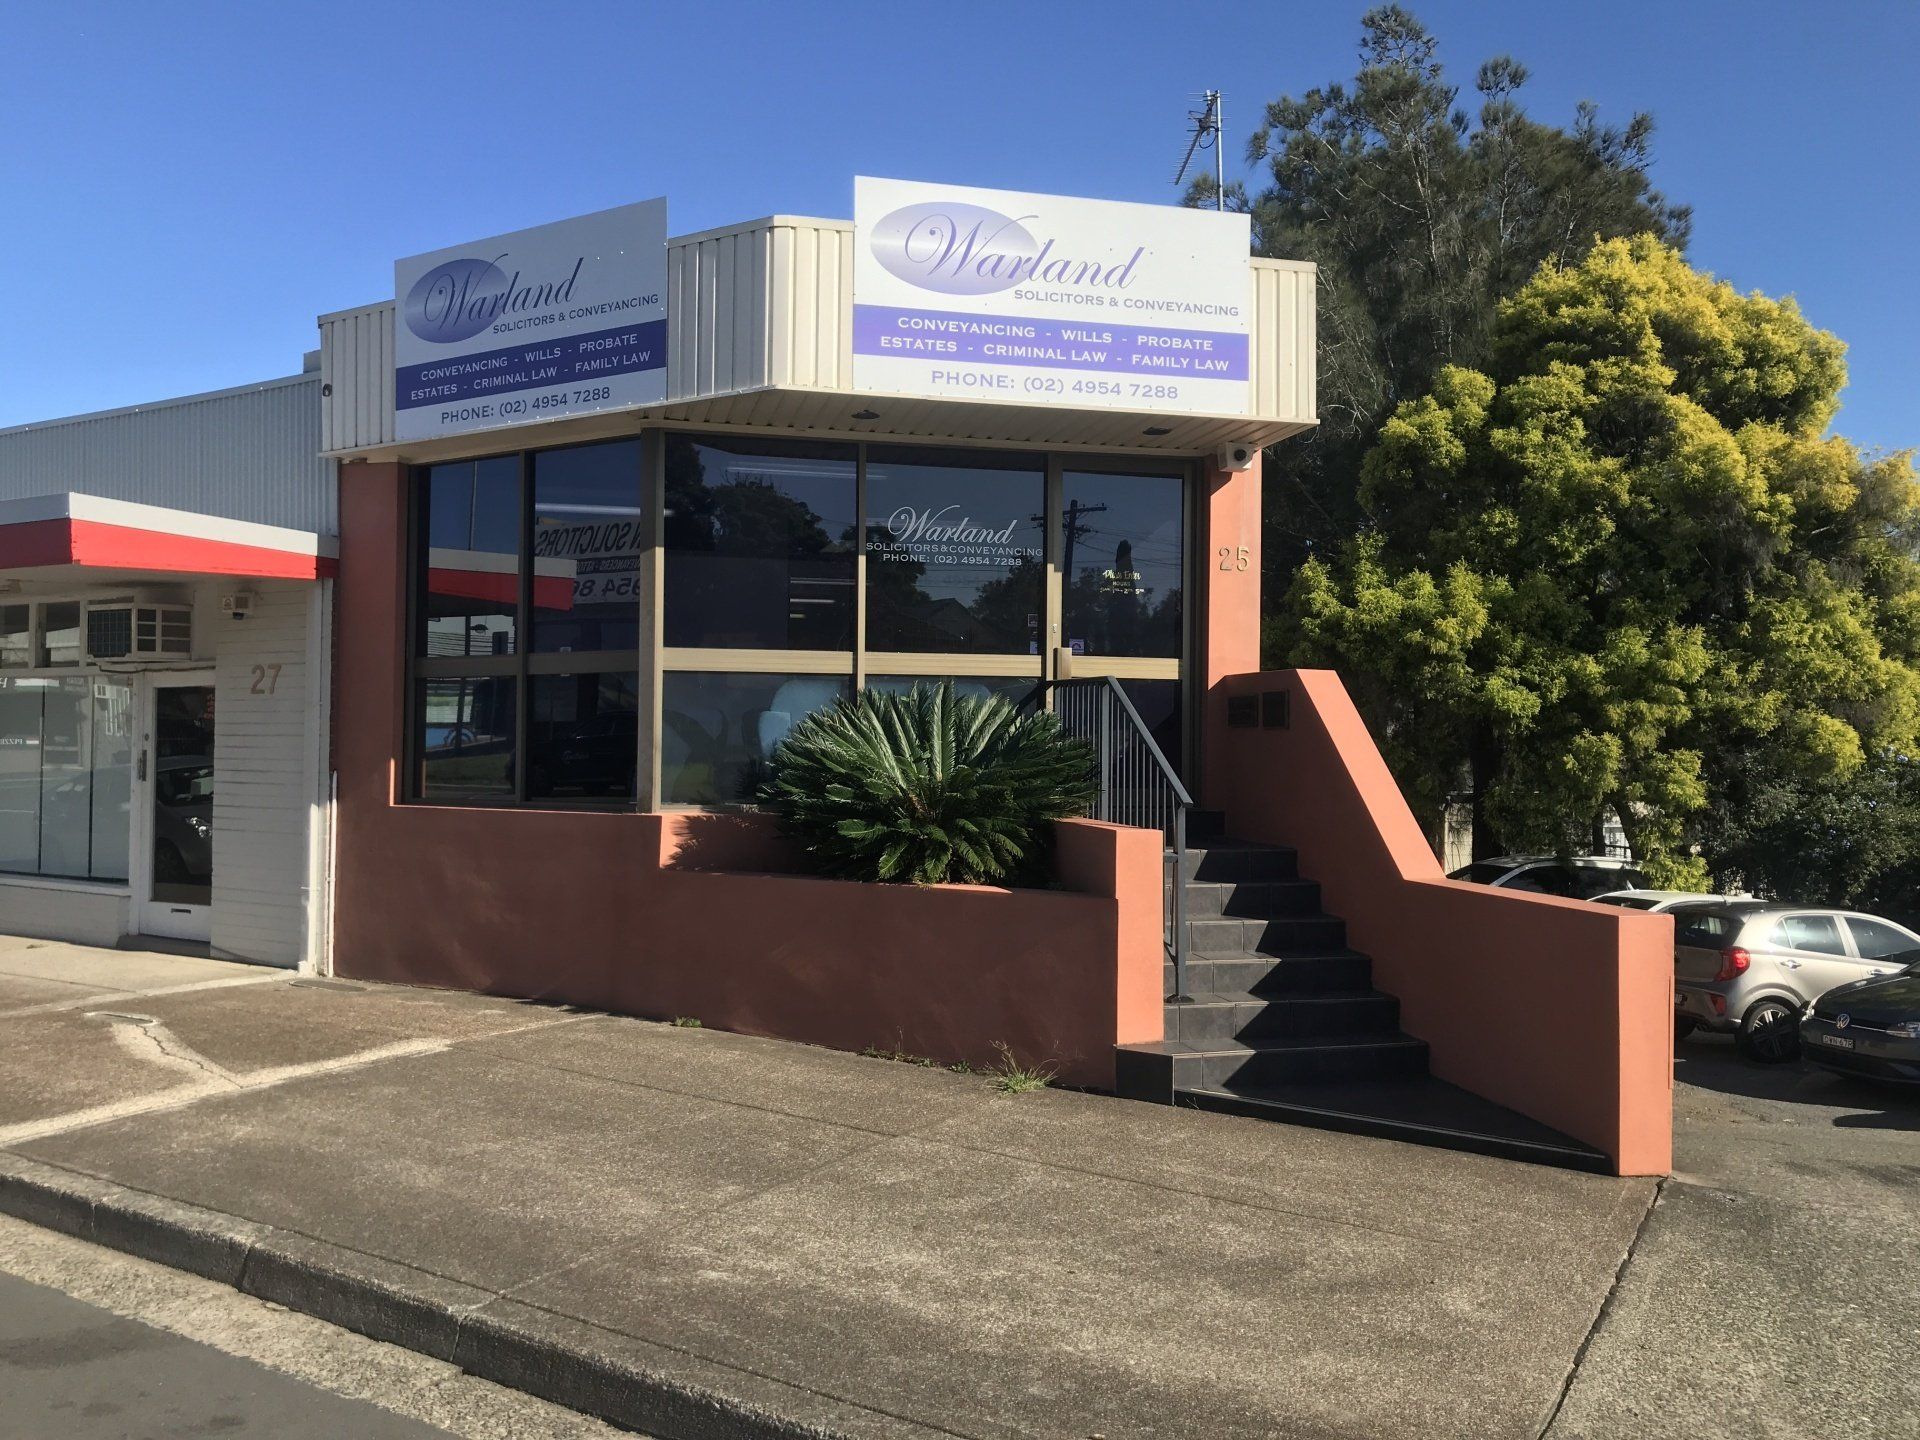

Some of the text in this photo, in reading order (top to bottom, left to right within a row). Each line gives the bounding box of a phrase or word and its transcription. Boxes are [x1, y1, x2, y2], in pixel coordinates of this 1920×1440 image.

[905, 213, 1145, 289] Warland
[424, 253, 584, 330] Warland
[1014, 289, 1240, 317] SOLICITORS & CONVEYANCING
[493, 294, 659, 334] SOLICITORS & CONVEYANCING
[897, 317, 1036, 338] CONVEYANCING
[1061, 329, 1112, 344] WILLS
[1137, 335, 1213, 351] PROBATE
[421, 356, 508, 381] CONVEYANCING
[525, 347, 561, 363] WILLS
[579, 333, 638, 354] PROBATE
[880, 336, 957, 353] ESTATES
[983, 344, 1066, 361] CRIMINAL
[1071, 350, 1107, 363] LAW
[1132, 354, 1191, 369] FAMILY
[1195, 359, 1229, 372] LAW
[411, 383, 457, 400] ESTATES
[473, 371, 529, 390] CRIMINAL
[532, 366, 558, 380] LAW
[575, 356, 620, 373] FAMILY
[623, 350, 651, 365] LAW
[931, 370, 1179, 400] PHONE: (02) 4954 7288
[441, 386, 611, 424] PHONE: (02) 4954 7288
[887, 504, 1018, 545] Warland
[883, 554, 1022, 566] PHONE: (02) 4954 7288
[1218, 546, 1249, 571] 25
[250, 662, 282, 695] 27
